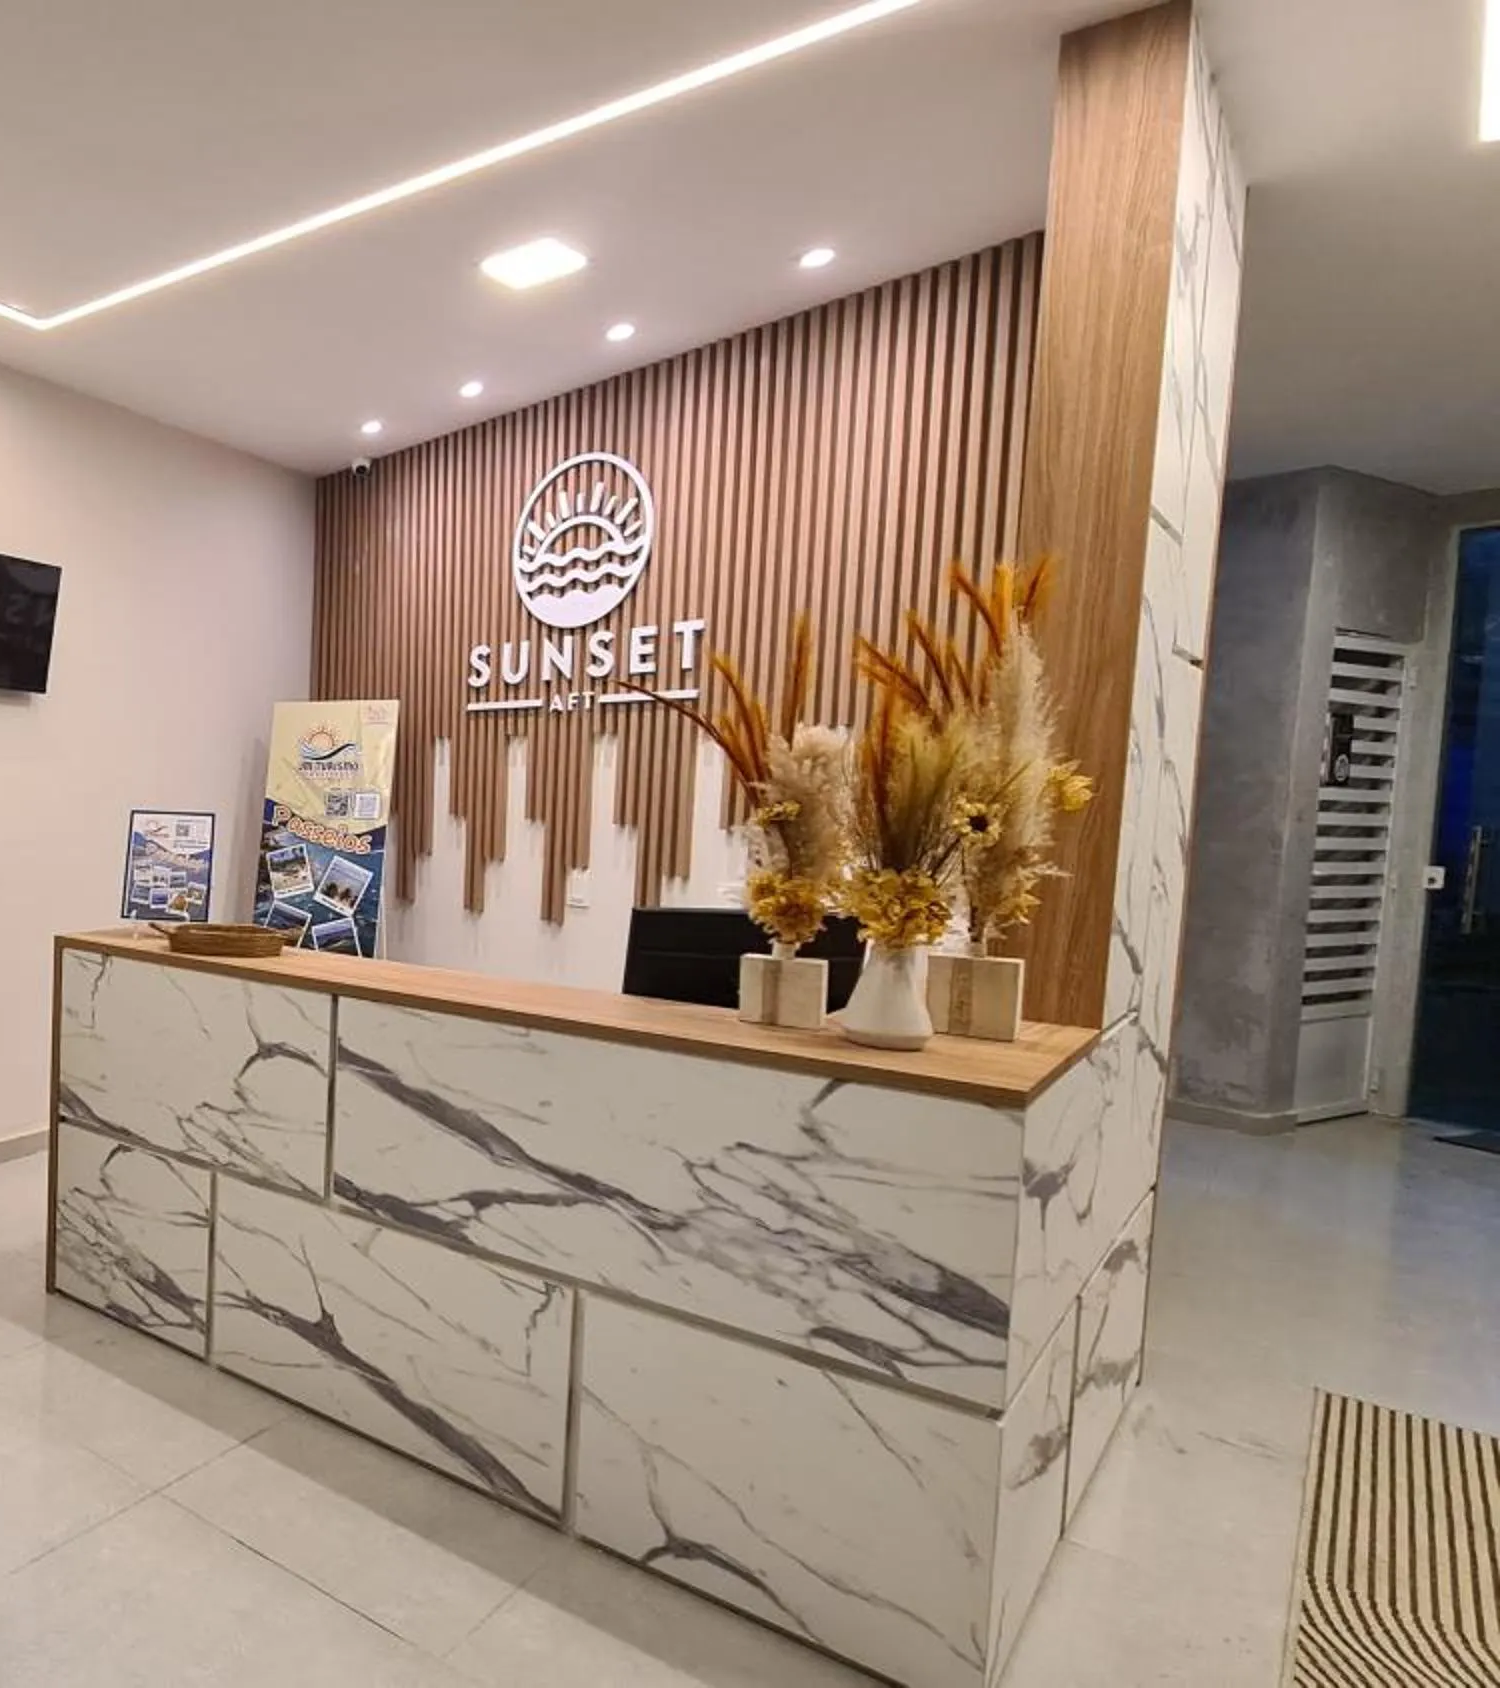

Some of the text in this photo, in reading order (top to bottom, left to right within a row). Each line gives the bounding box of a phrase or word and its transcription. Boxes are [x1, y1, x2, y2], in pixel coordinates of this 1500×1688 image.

[467, 619, 705, 687] SUNSET
[550, 692, 595, 713] AFT
[272, 804, 372, 854] Passeios
